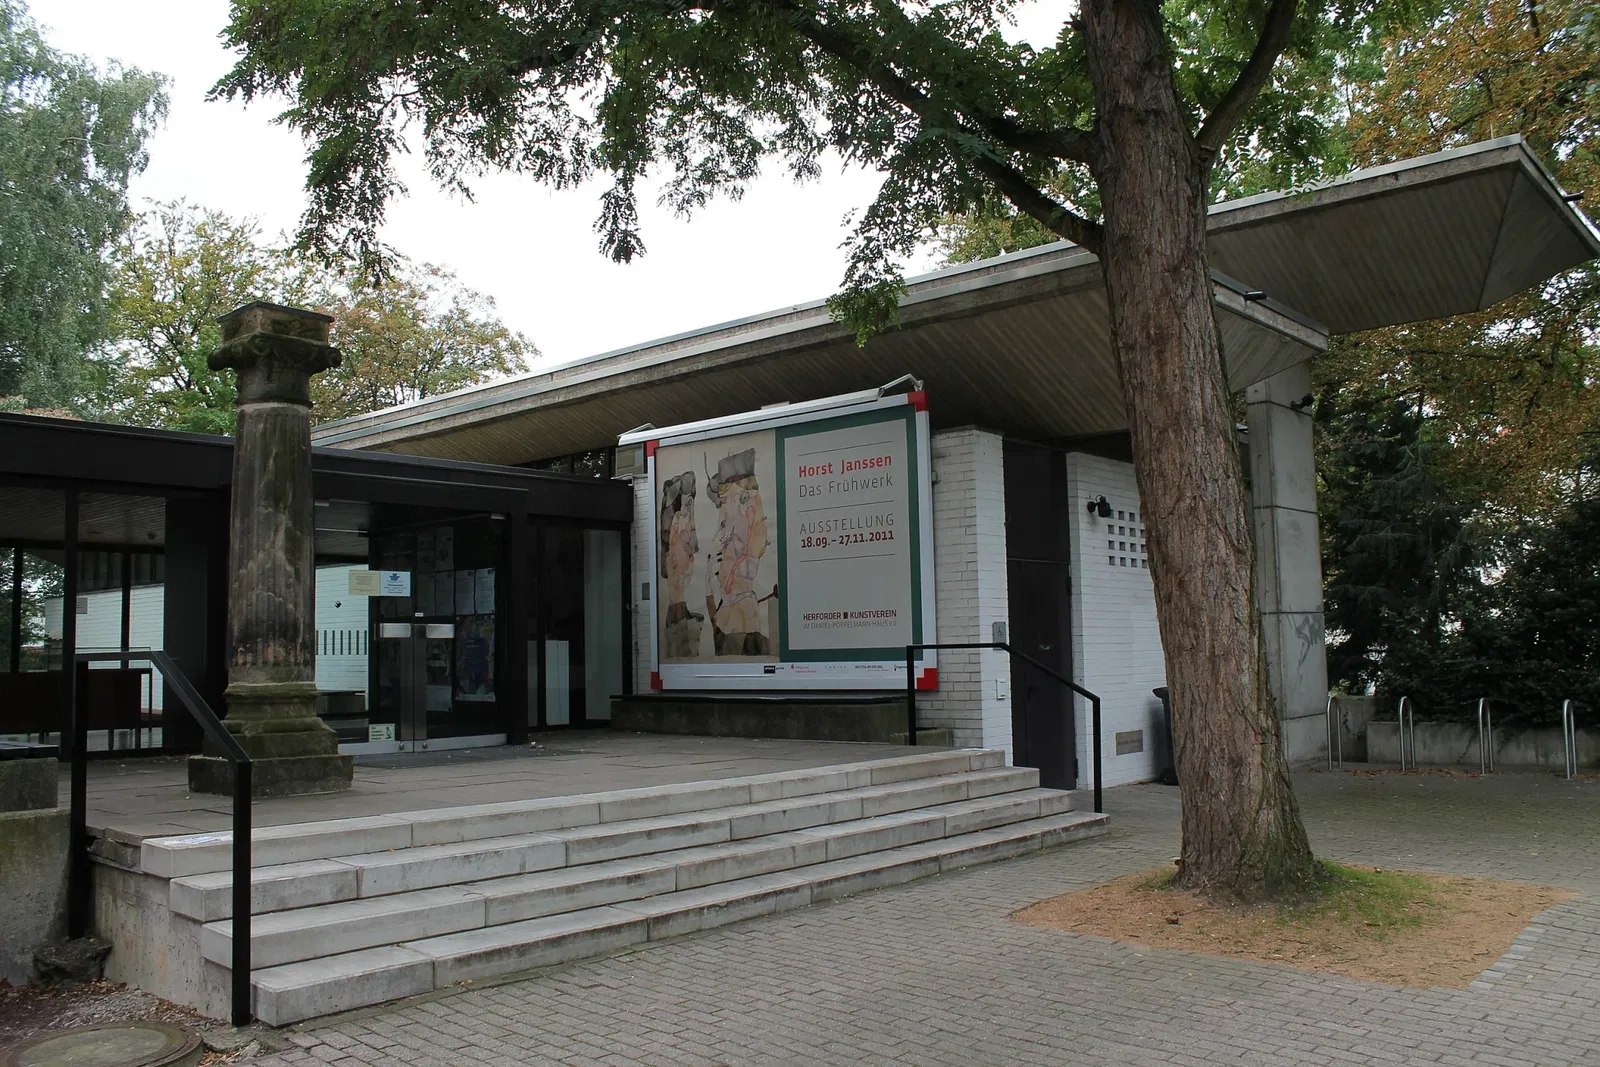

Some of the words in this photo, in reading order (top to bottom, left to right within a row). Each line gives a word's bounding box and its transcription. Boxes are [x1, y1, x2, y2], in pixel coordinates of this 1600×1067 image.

[798, 462, 834, 478] Horst
[840, 456, 892, 474] Janssen
[800, 484, 822, 498] Das
[828, 472, 893, 494] Frühwerk
[800, 513, 894, 535] AUSSTELLUNG
[803, 612, 842, 621] HERFORDER
[850, 610, 896, 620] KUNSTVEREIN
